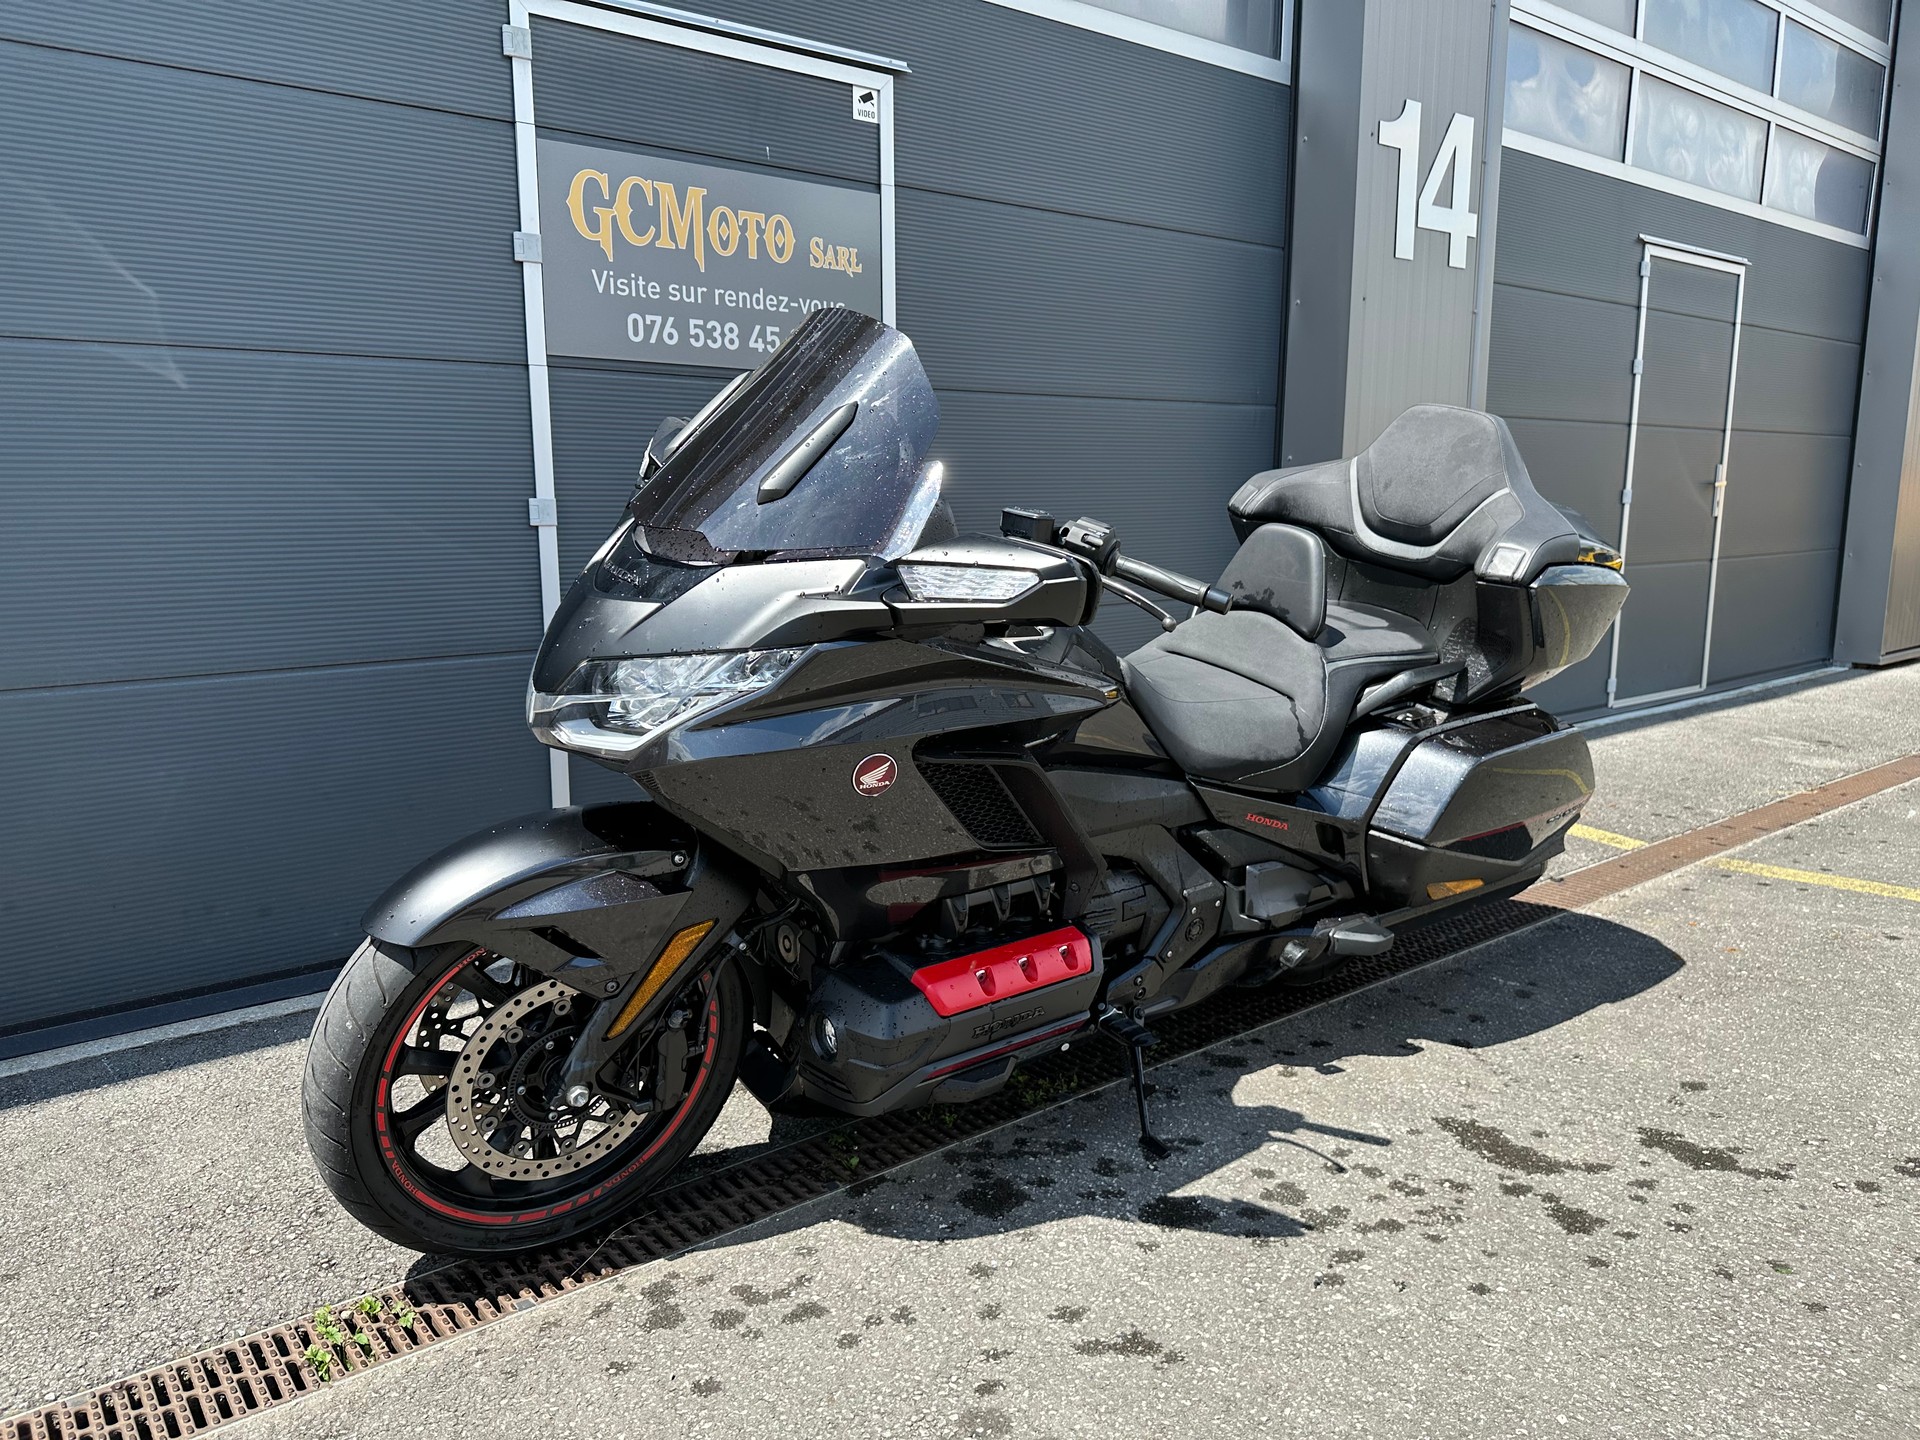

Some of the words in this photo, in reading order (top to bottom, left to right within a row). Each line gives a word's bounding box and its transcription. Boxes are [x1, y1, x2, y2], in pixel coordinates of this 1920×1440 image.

[857, 108, 876, 119] VIDEO
[1377, 97, 1478, 269] 14
[591, 268, 661, 299] Visite
[668, 283, 708, 304] sur
[627, 312, 679, 346] 076
[689, 318, 740, 351] 538
[748, 324, 781, 354] 45
[859, 780, 891, 790] HONDA
[1245, 812, 1289, 830] HONDA
[457, 946, 487, 969] HON
[970, 1006, 1047, 1040] HONDA
[391, 1159, 419, 1195] HONDA
[603, 1157, 645, 1188] HONDA
